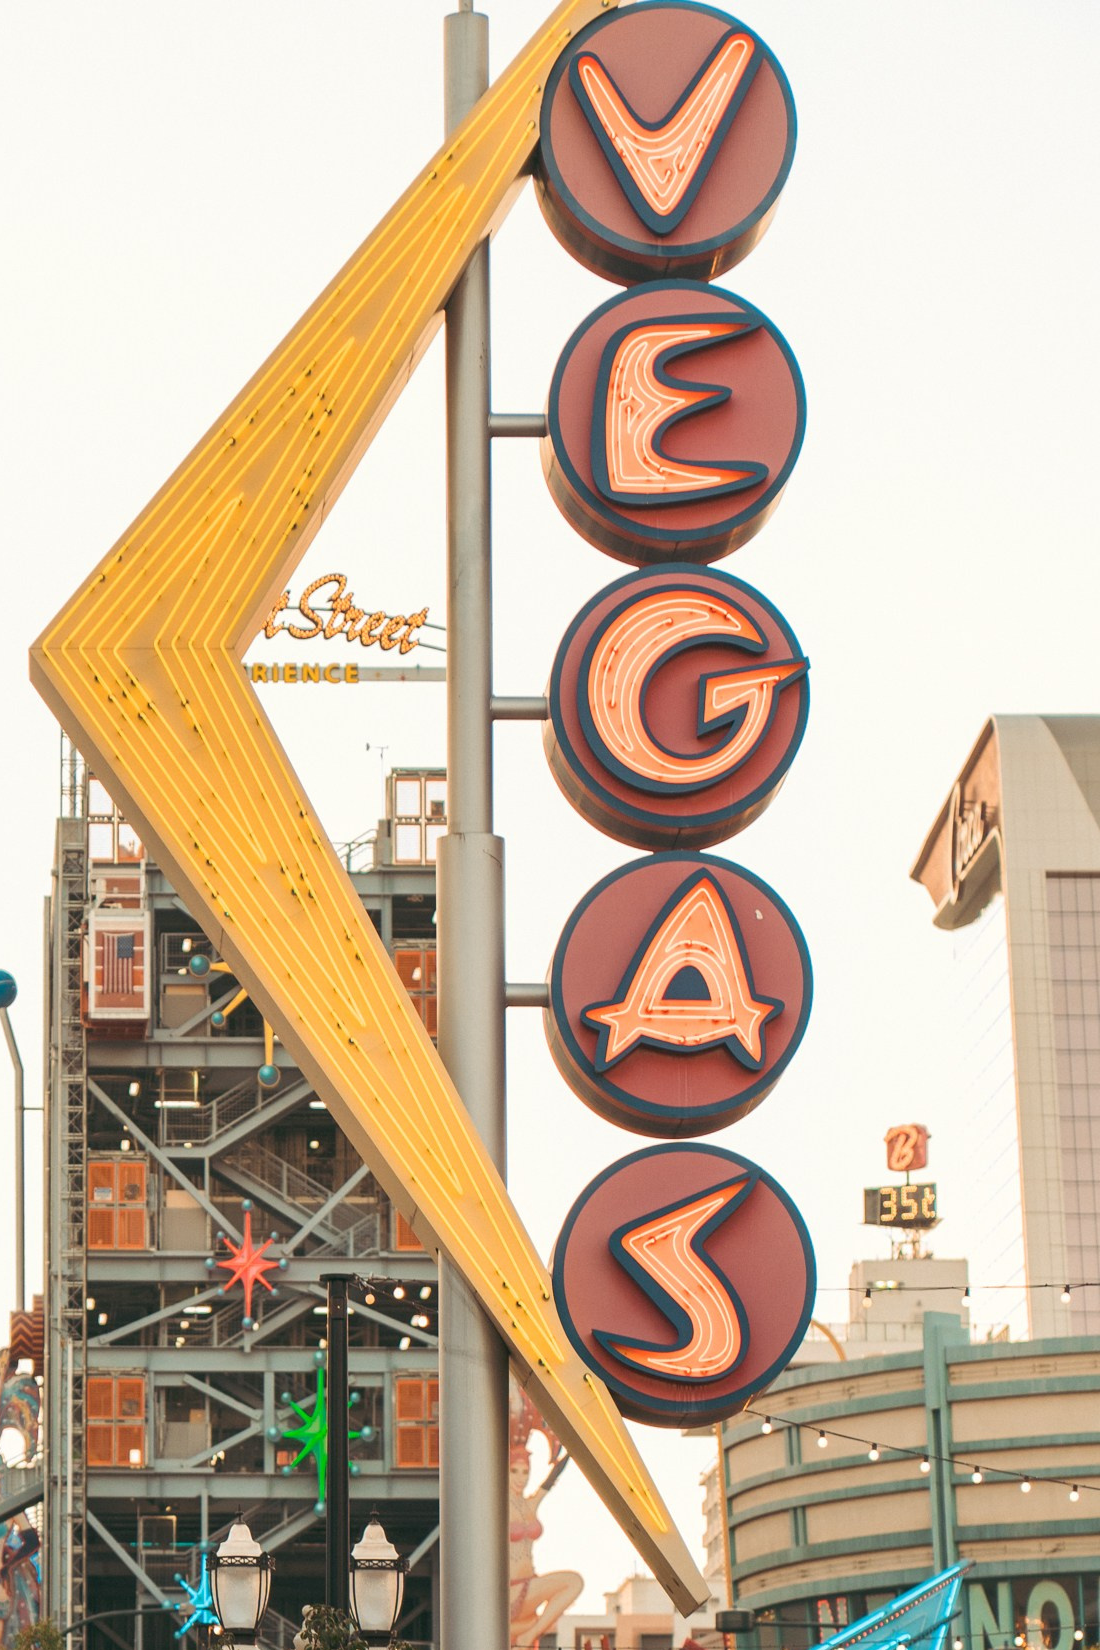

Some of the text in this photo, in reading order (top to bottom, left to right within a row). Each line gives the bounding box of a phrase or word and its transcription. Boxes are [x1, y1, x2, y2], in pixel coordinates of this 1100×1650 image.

[288, 573, 430, 655] Street
[243, 663, 359, 684] RIENCE
[569, 26, 810, 1383] VEGAS
